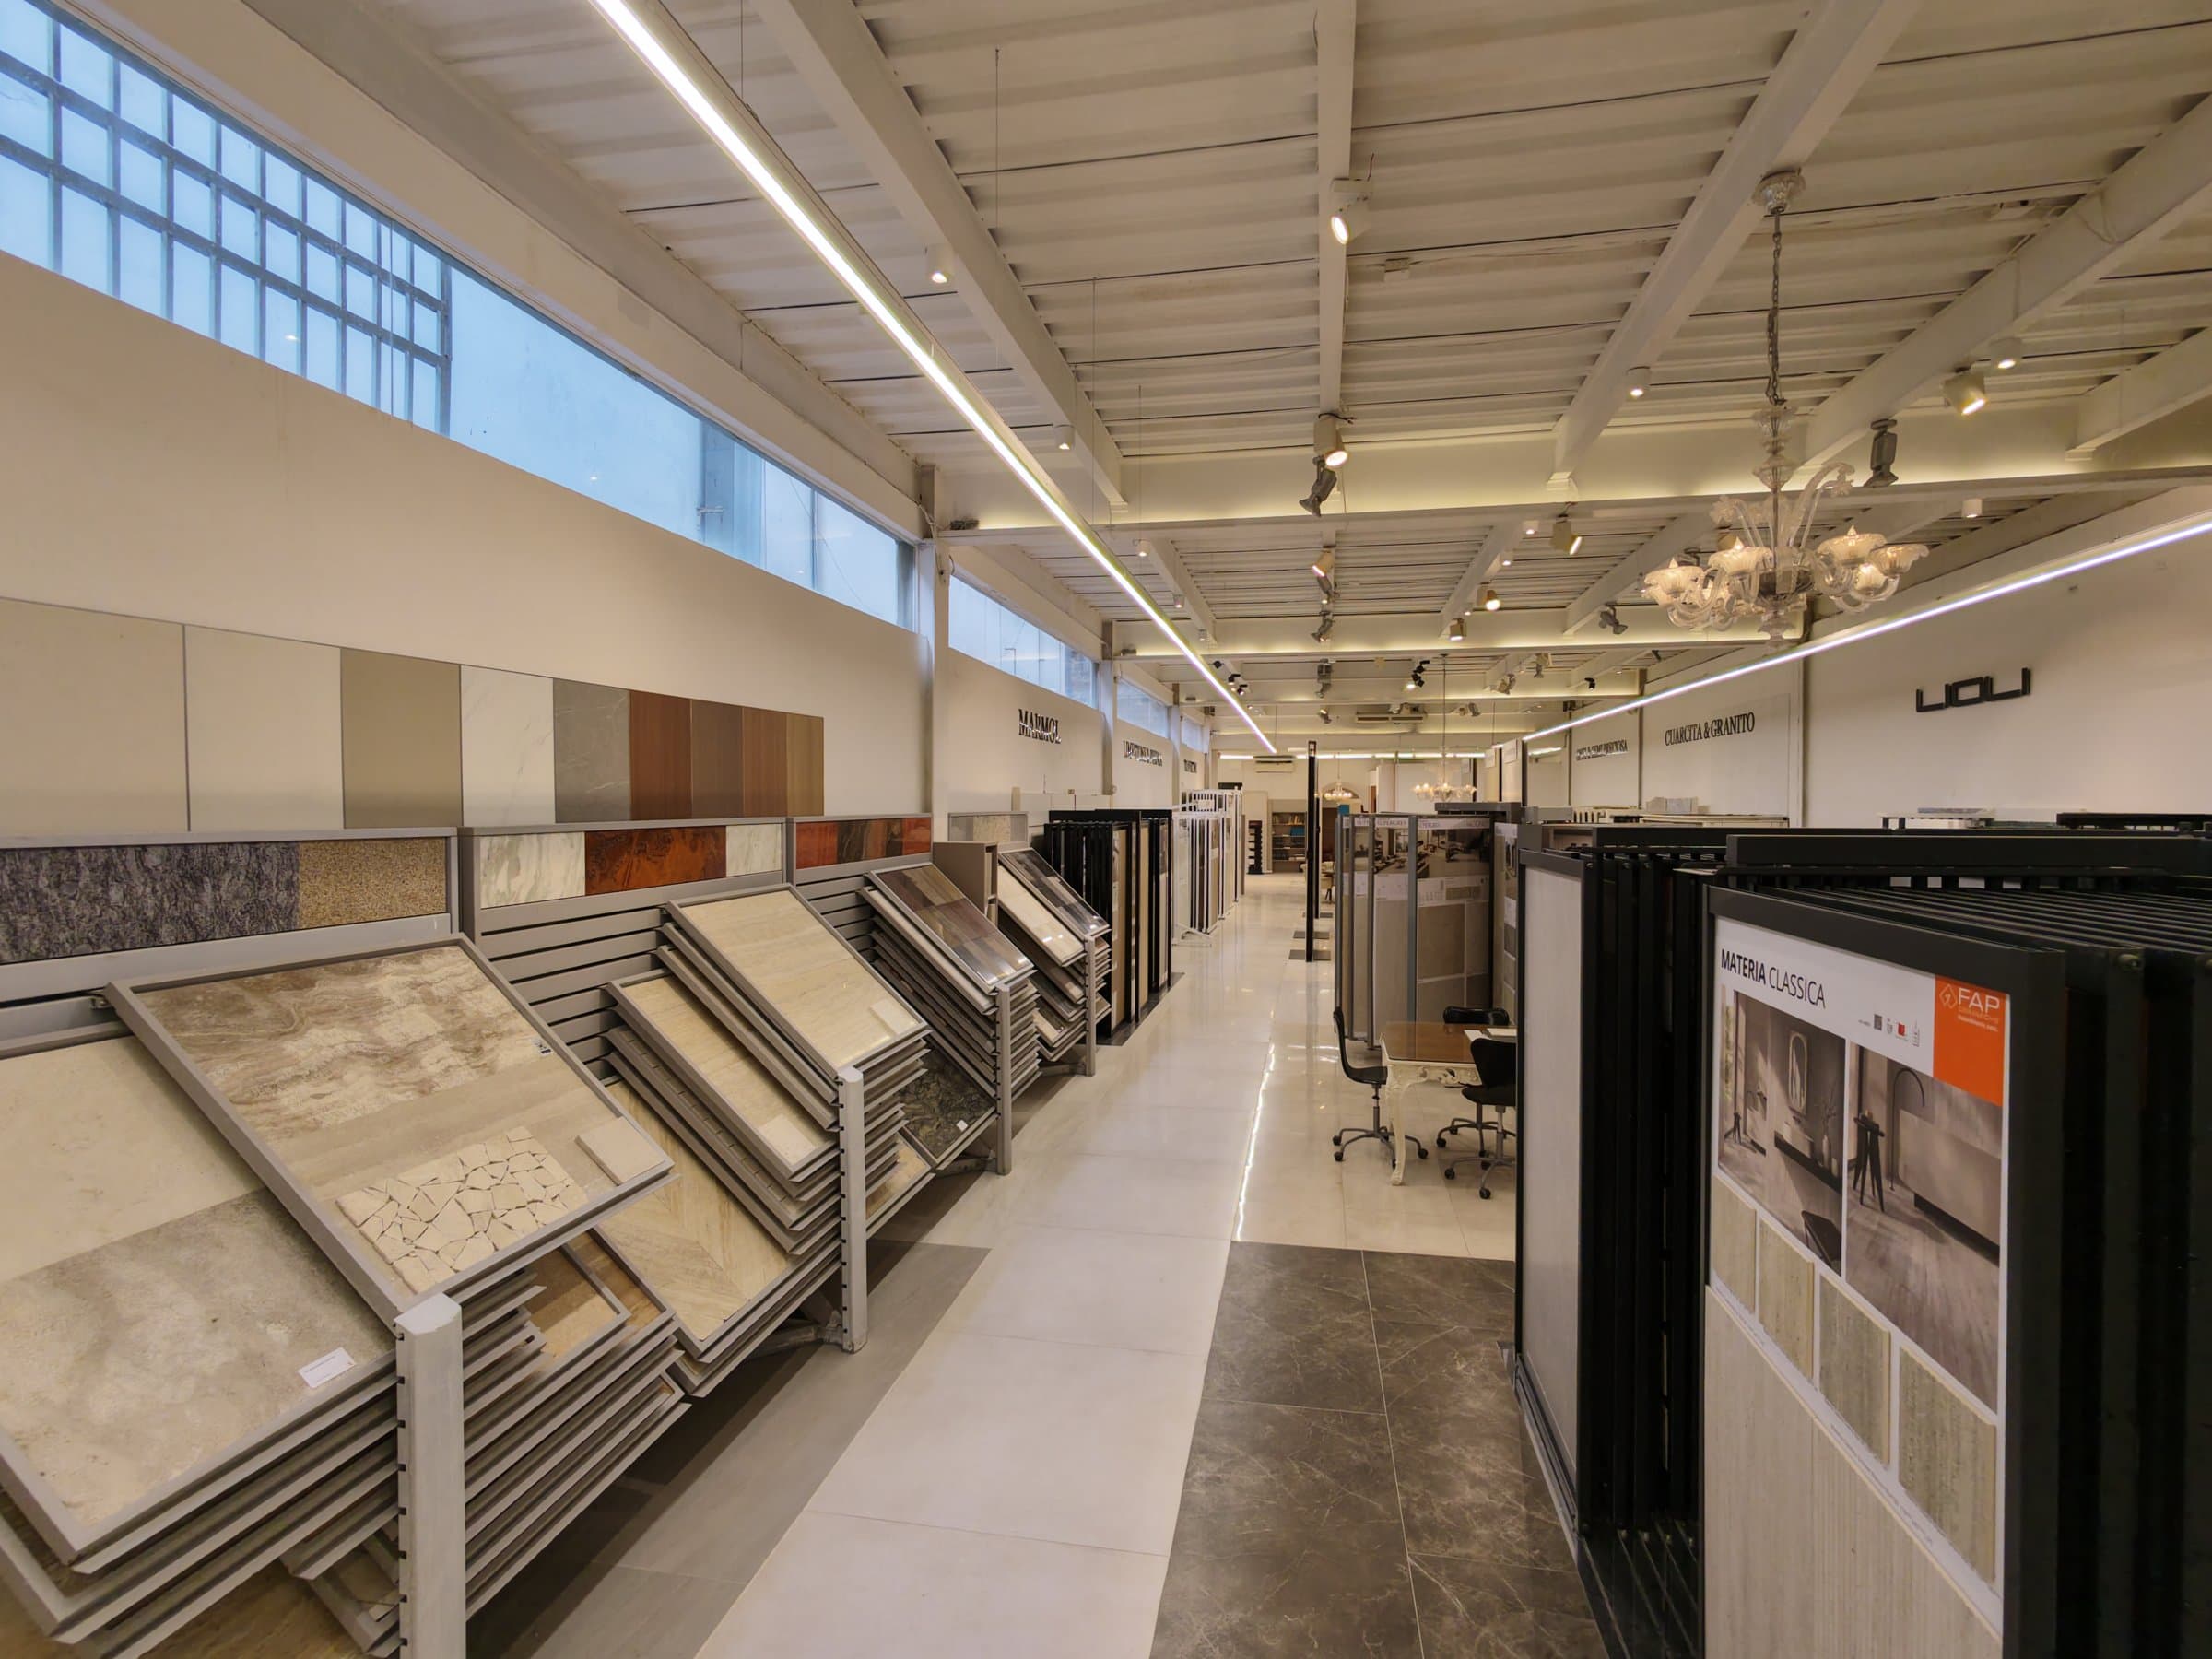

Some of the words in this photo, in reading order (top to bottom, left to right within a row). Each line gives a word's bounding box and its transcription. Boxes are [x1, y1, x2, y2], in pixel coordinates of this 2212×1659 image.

[1018, 709, 1061, 744] MARMOL
[1665, 723, 1702, 746] CUARCITA
[1703, 721, 1710, 739] &
[1711, 712, 1755, 738] GRANITO
[1721, 949, 1766, 985] MATERIA
[1769, 967, 1826, 1009] CLASSICA
[1959, 987, 2000, 1014] FAP
